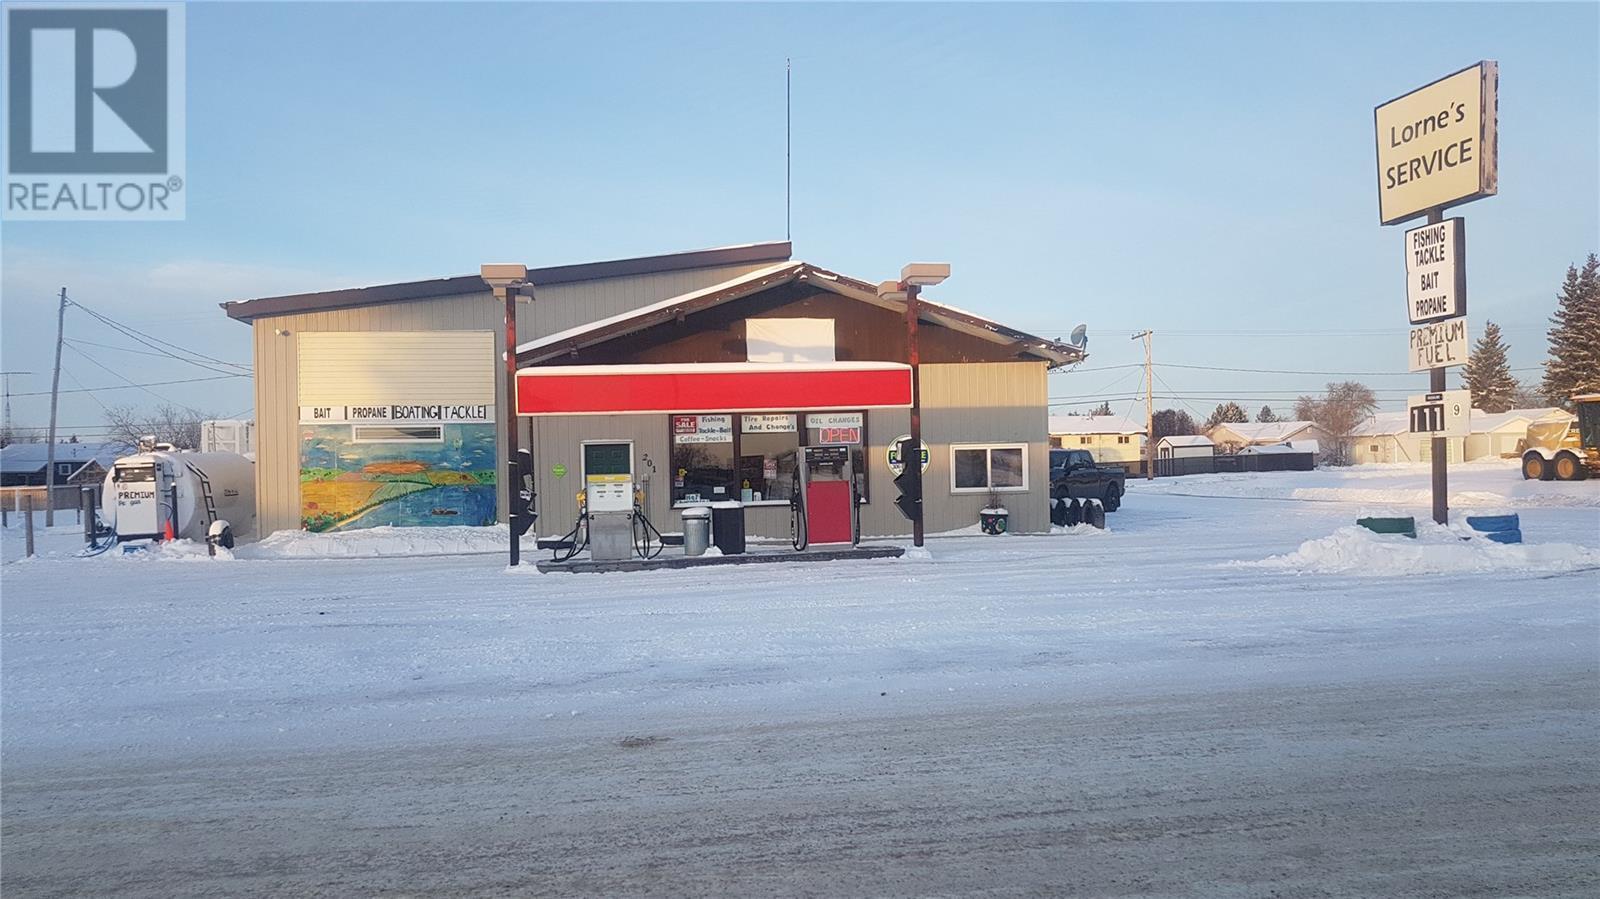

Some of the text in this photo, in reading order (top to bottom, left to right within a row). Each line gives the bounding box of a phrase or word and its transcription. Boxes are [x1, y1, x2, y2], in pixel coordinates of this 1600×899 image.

[1390, 101, 1465, 149] Lorne's
[1386, 137, 1473, 190] SERVICE
[1413, 225, 1446, 250] FISHING
[1415, 244, 1446, 267] TACKLE
[1420, 271, 1439, 291] BAIT
[1415, 295, 1447, 318] PROPANE
[1410, 319, 1464, 350] PREMIUM
[1418, 342, 1456, 366] FUEL
[313, 405, 485, 419] BAIT PROPANE BOATING TACKLE
[701, 416, 726, 424] Fishing
[828, 416, 860, 424] CHANGES
[1453, 404, 1461, 416] 9
[820, 427, 858, 443] OPEN
[118, 491, 155, 499] PREMIUM
